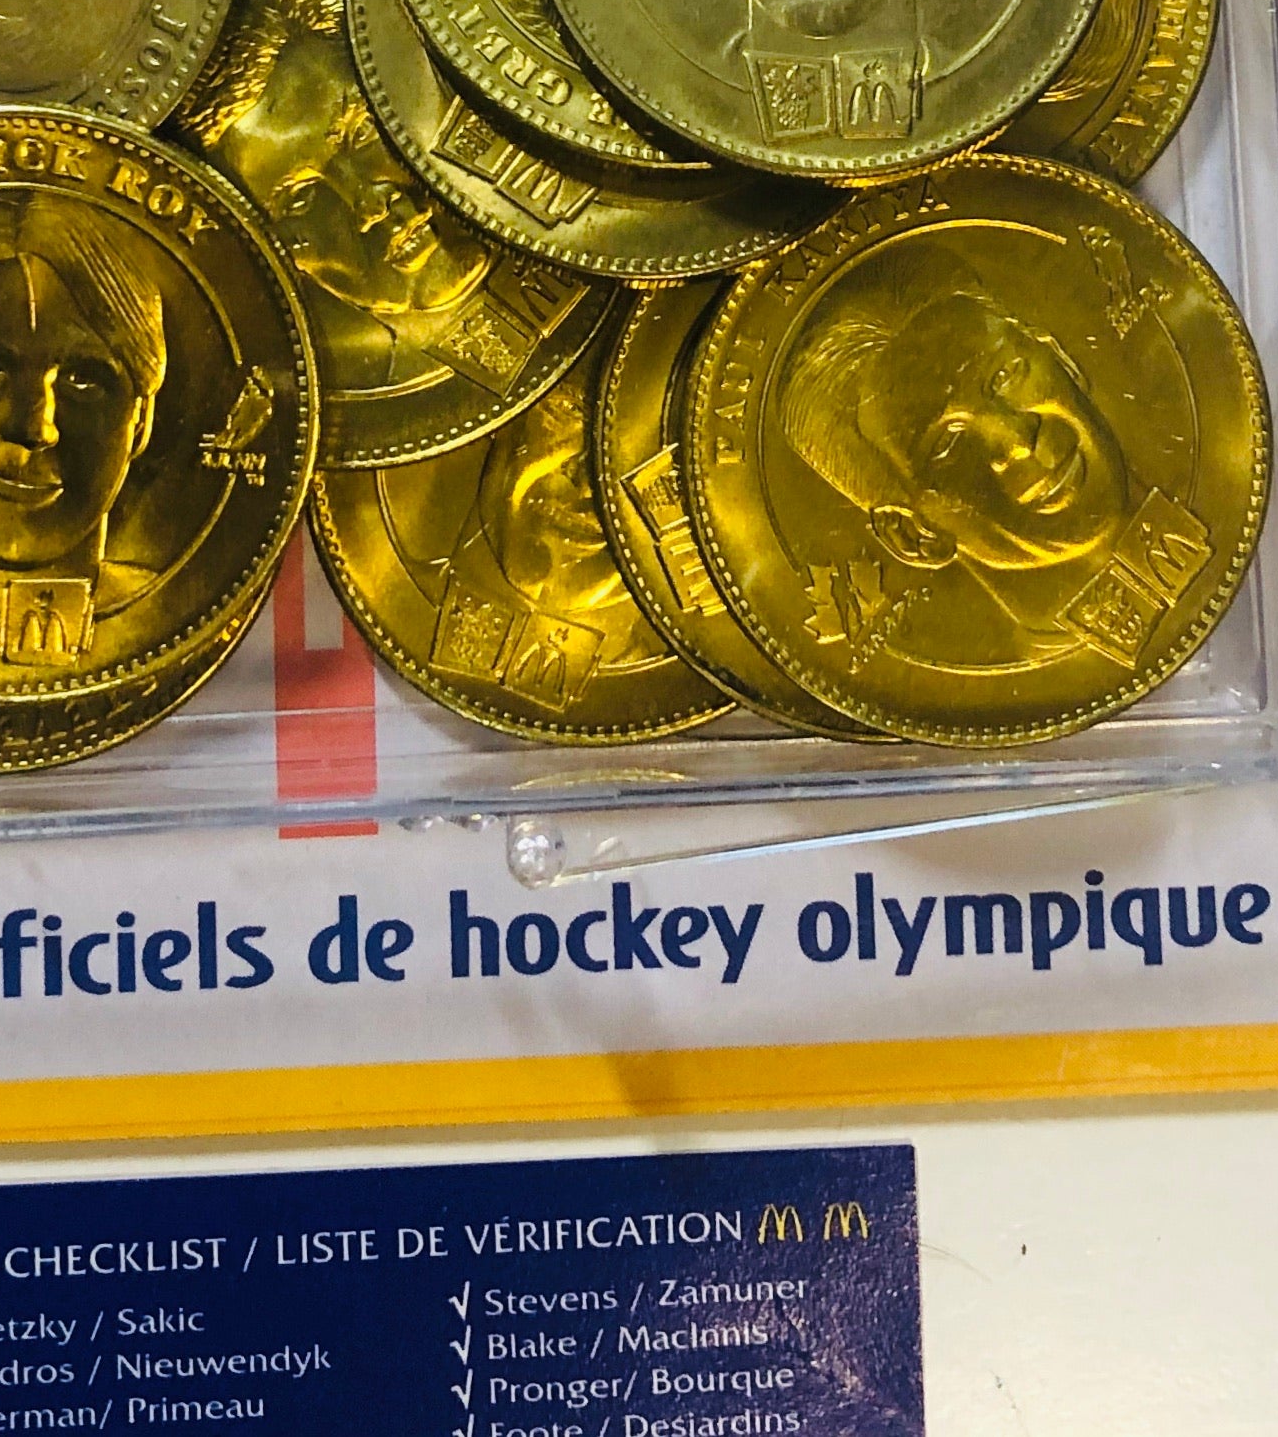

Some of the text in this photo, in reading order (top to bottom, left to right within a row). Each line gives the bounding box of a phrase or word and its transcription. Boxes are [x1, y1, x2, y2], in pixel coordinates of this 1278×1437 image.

[106, 163, 220, 248] ROY
[712, 175, 951, 465] PAUL KARIYA
[308, 895, 414, 985] de
[449, 883, 765, 985] hockey
[797, 869, 1271, 977] olympique
[4, 1237, 226, 1279] CHECKLIST
[276, 1229, 379, 1266] LISTE
[398, 1226, 449, 1259] DE
[465, 1211, 743, 1255] VÉRIFICATION
[484, 1284, 618, 1317] Stevens
[658, 1279, 808, 1309] Zamuner
[117, 1308, 206, 1336] Sakic
[487, 1331, 578, 1361] Blake
[617, 1322, 770, 1354] MacInnis
[116, 1344, 332, 1382] Nieuwendyk
[650, 1366, 795, 1401] Bourque
[127, 1397, 265, 1425] Primeau
[623, 1406, 802, 1437] Desjardins
